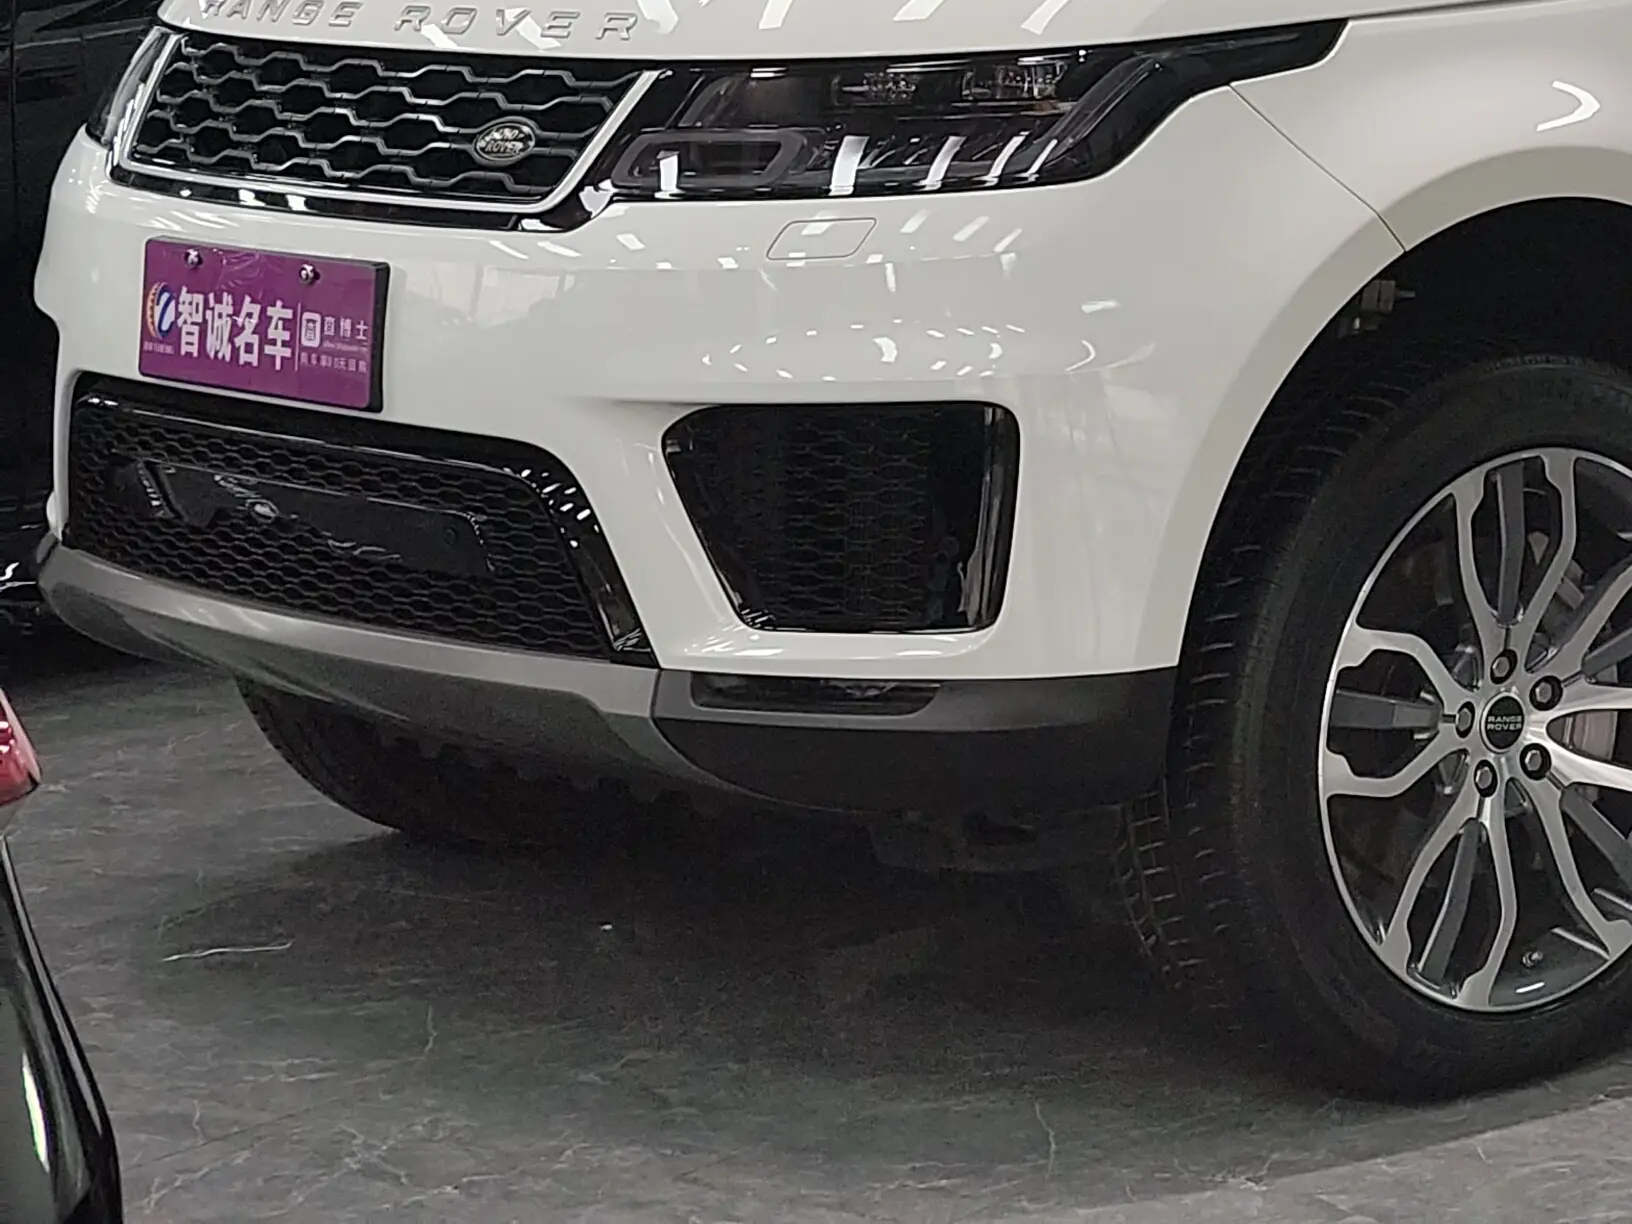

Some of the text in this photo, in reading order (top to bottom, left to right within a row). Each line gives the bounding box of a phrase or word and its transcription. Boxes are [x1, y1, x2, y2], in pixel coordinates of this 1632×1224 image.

[394, 5, 638, 41] ROVER
[485, 140, 523, 153] ROVER
[177, 285, 294, 371] 智诚名车
[1487, 715, 1522, 723] RANGE
[1486, 723, 1522, 731] ROVER
